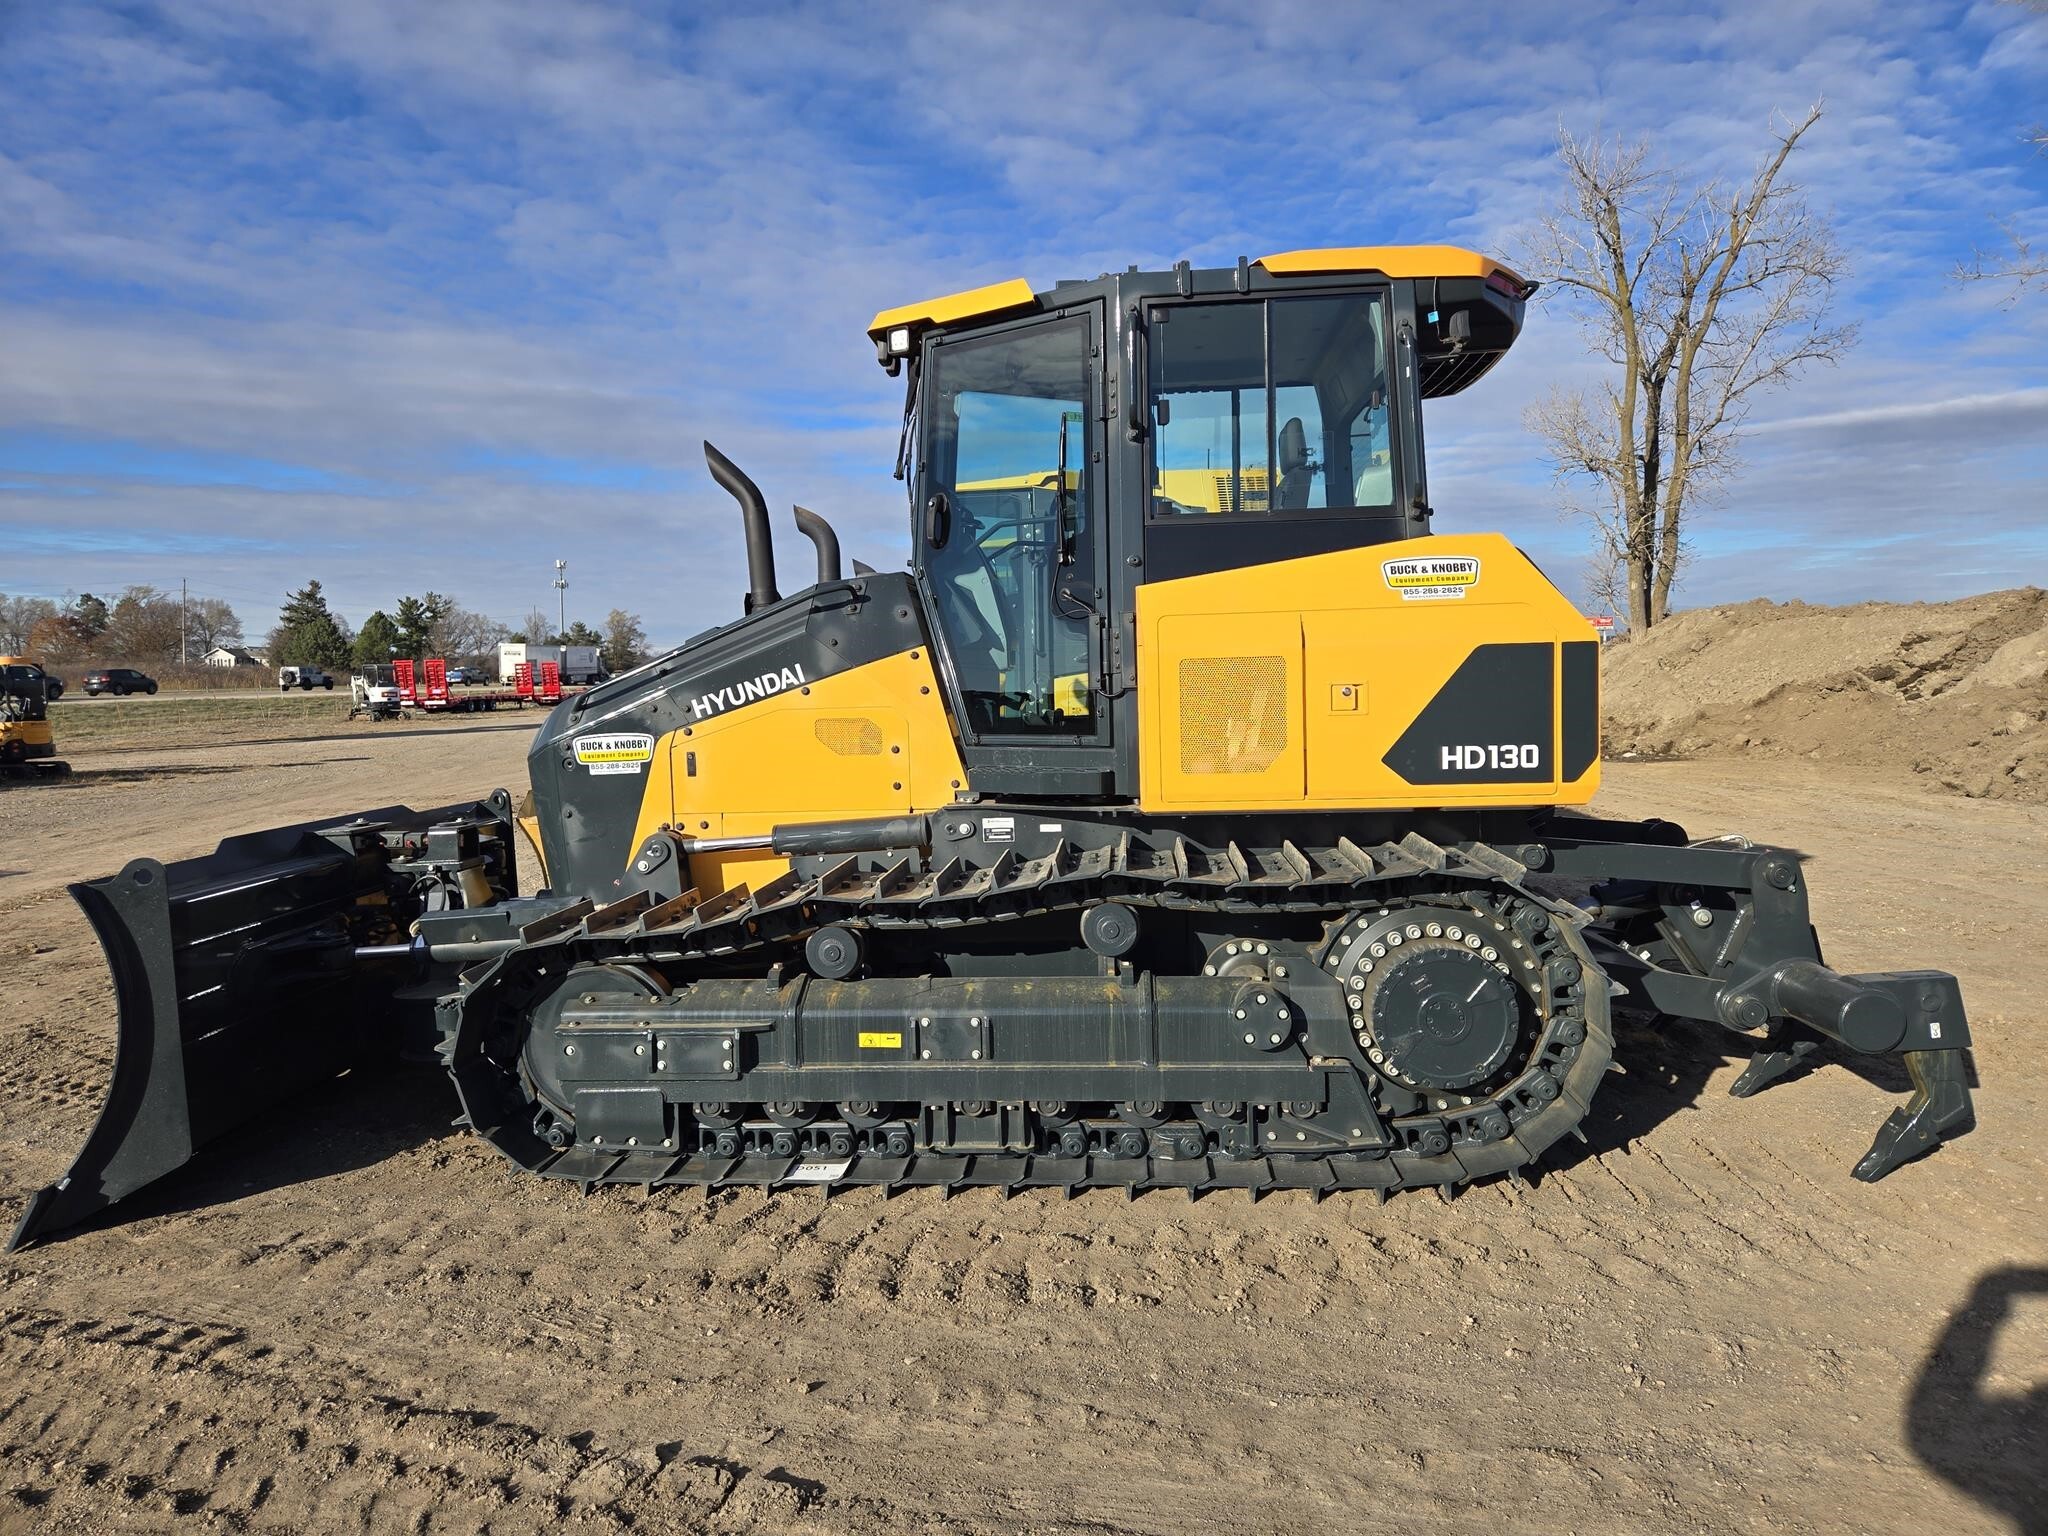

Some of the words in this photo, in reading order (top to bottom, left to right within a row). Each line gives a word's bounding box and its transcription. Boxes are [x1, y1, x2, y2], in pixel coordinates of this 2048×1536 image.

[1390, 564, 1418, 575] BUCK
[1421, 565, 1428, 574] &
[1431, 562, 1473, 573] KNOBBY
[1403, 586, 1464, 595] 855-288-2825
[690, 663, 806, 719] HYUNDAI
[580, 741, 604, 751] BUCK
[606, 742, 612, 750] &
[614, 739, 648, 750] KNOBBY
[1441, 744, 1539, 770] HD130
